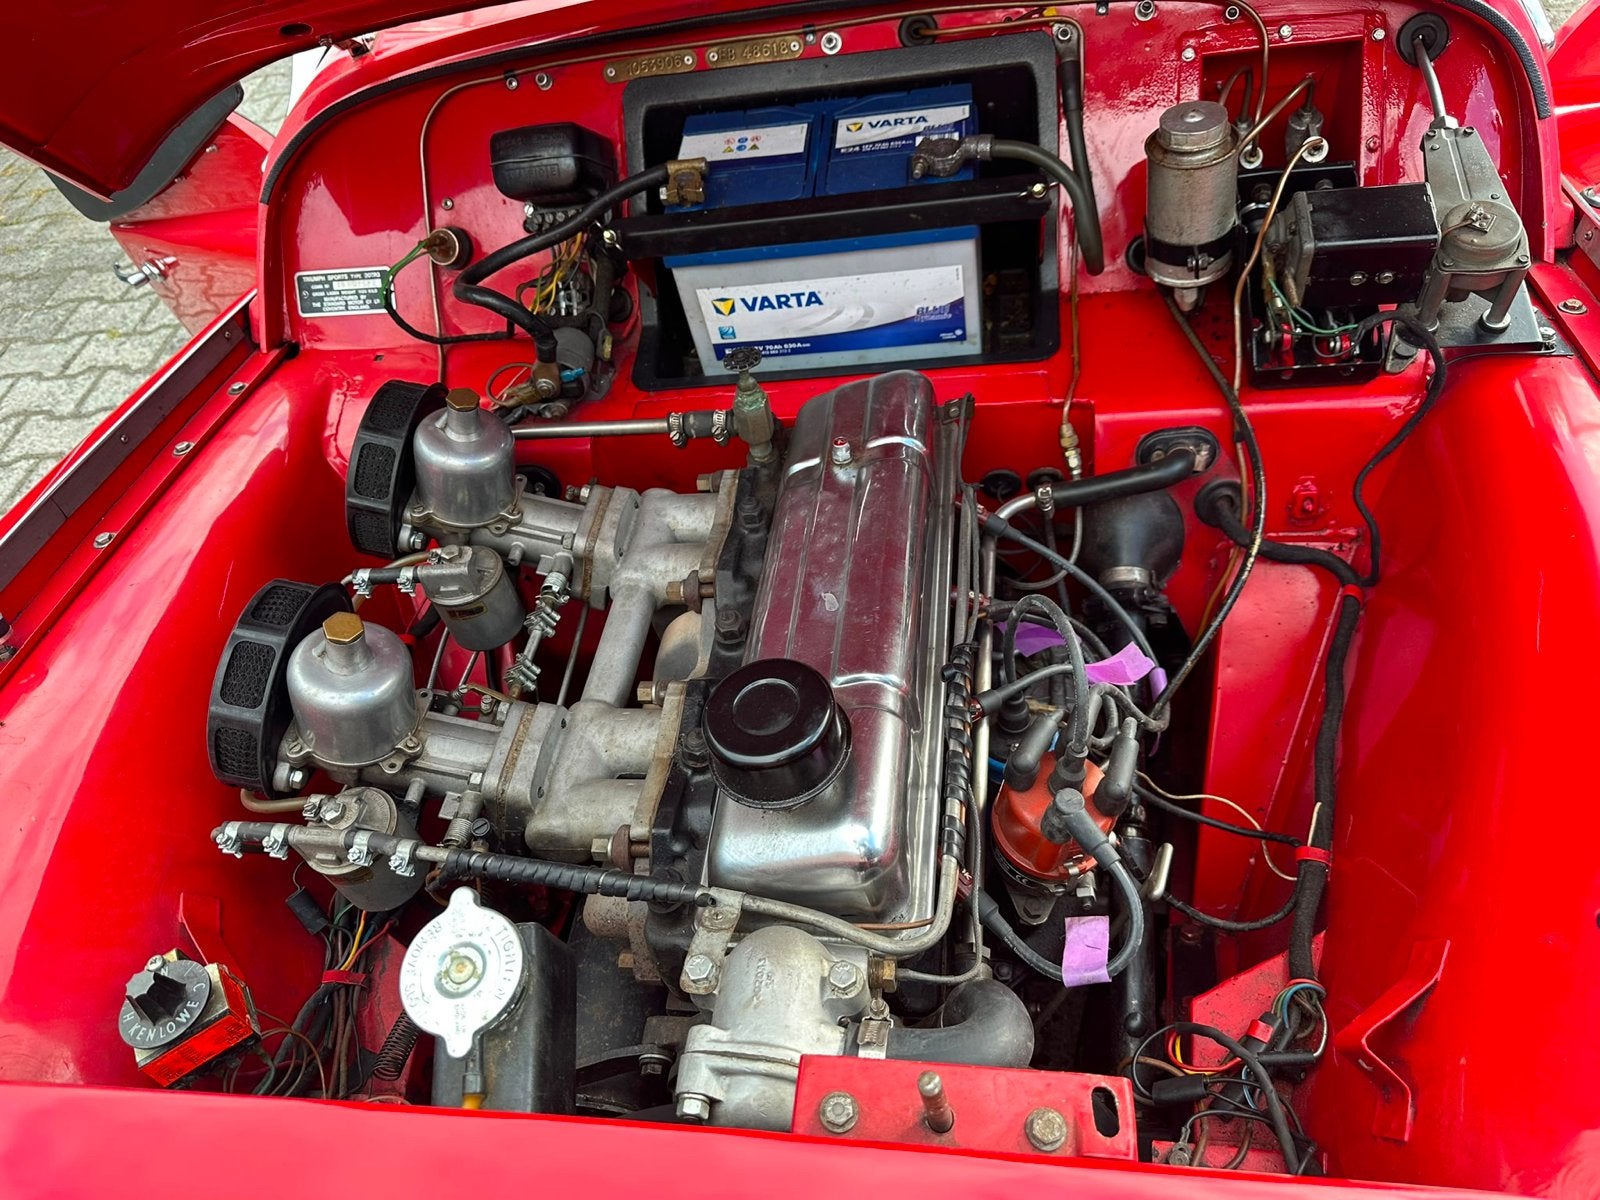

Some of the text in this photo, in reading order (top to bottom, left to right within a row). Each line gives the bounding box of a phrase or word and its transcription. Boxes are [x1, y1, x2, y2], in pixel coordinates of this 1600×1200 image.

[742, 40, 789, 60] 48618
[868, 115, 928, 129] VARTA
[740, 291, 824, 312] VARTA
[128, 1000, 200, 1042] KENLOWE
